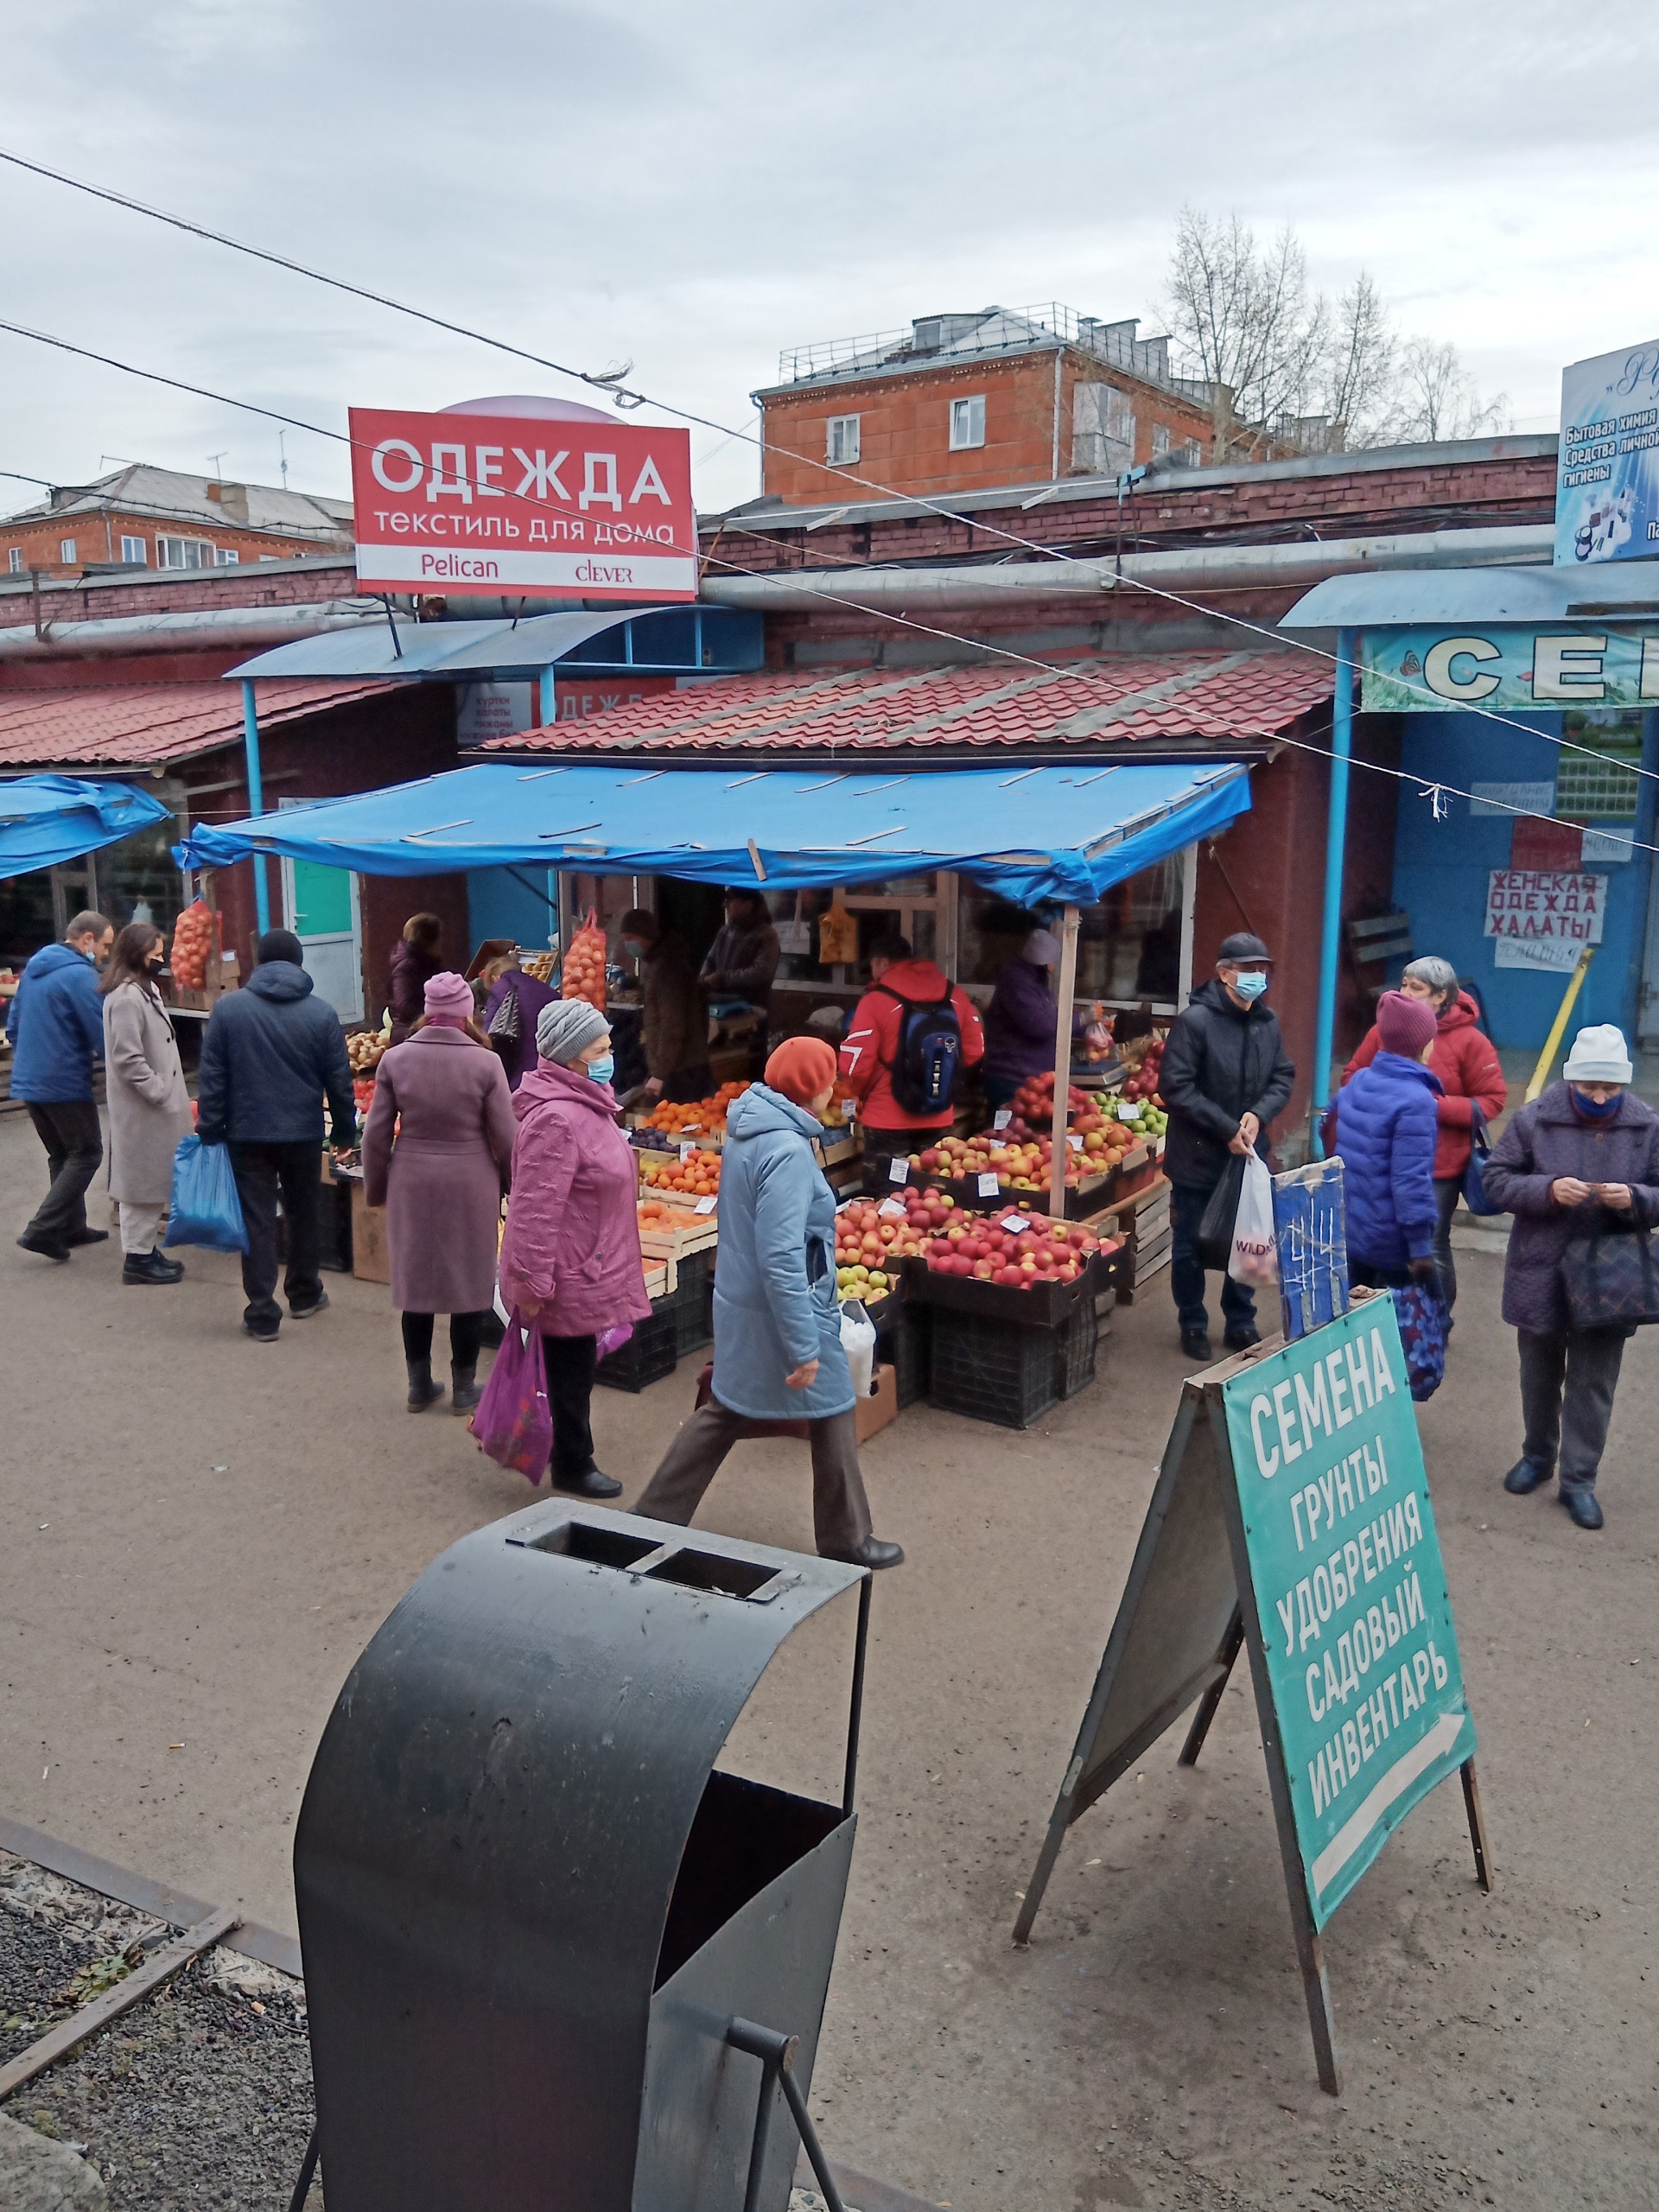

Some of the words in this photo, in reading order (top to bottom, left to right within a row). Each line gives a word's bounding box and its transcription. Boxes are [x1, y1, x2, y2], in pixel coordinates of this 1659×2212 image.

[1565, 418, 1616, 446] Бытовая
[1618, 408, 1658, 433] химия
[1565, 440, 1616, 467] Средства
[371, 439, 672, 512] ОДЕЖДА
[1563, 464, 1611, 488] гигиены
[373, 510, 520, 538] текстиль
[528, 518, 585, 543] для
[594, 523, 674, 545] дома
[422, 554, 499, 578] Pelican
[1492, 872, 1598, 893] ЖЕНСКАЯ
[1490, 891, 1597, 913] ОДЕЖДА
[1490, 913, 1592, 939] ХАЛАТЫ
[1249, 1326, 1396, 1480] СЕМЕНА
[1289, 1434, 1389, 1552] ГРУНТЫ
[1276, 1490, 1423, 1658] УДОБРЕНИЯ
[1306, 1560, 1425, 1723] САДОВЫЙ
[1307, 1641, 1448, 1819] ИНВЕНТАРЬ
